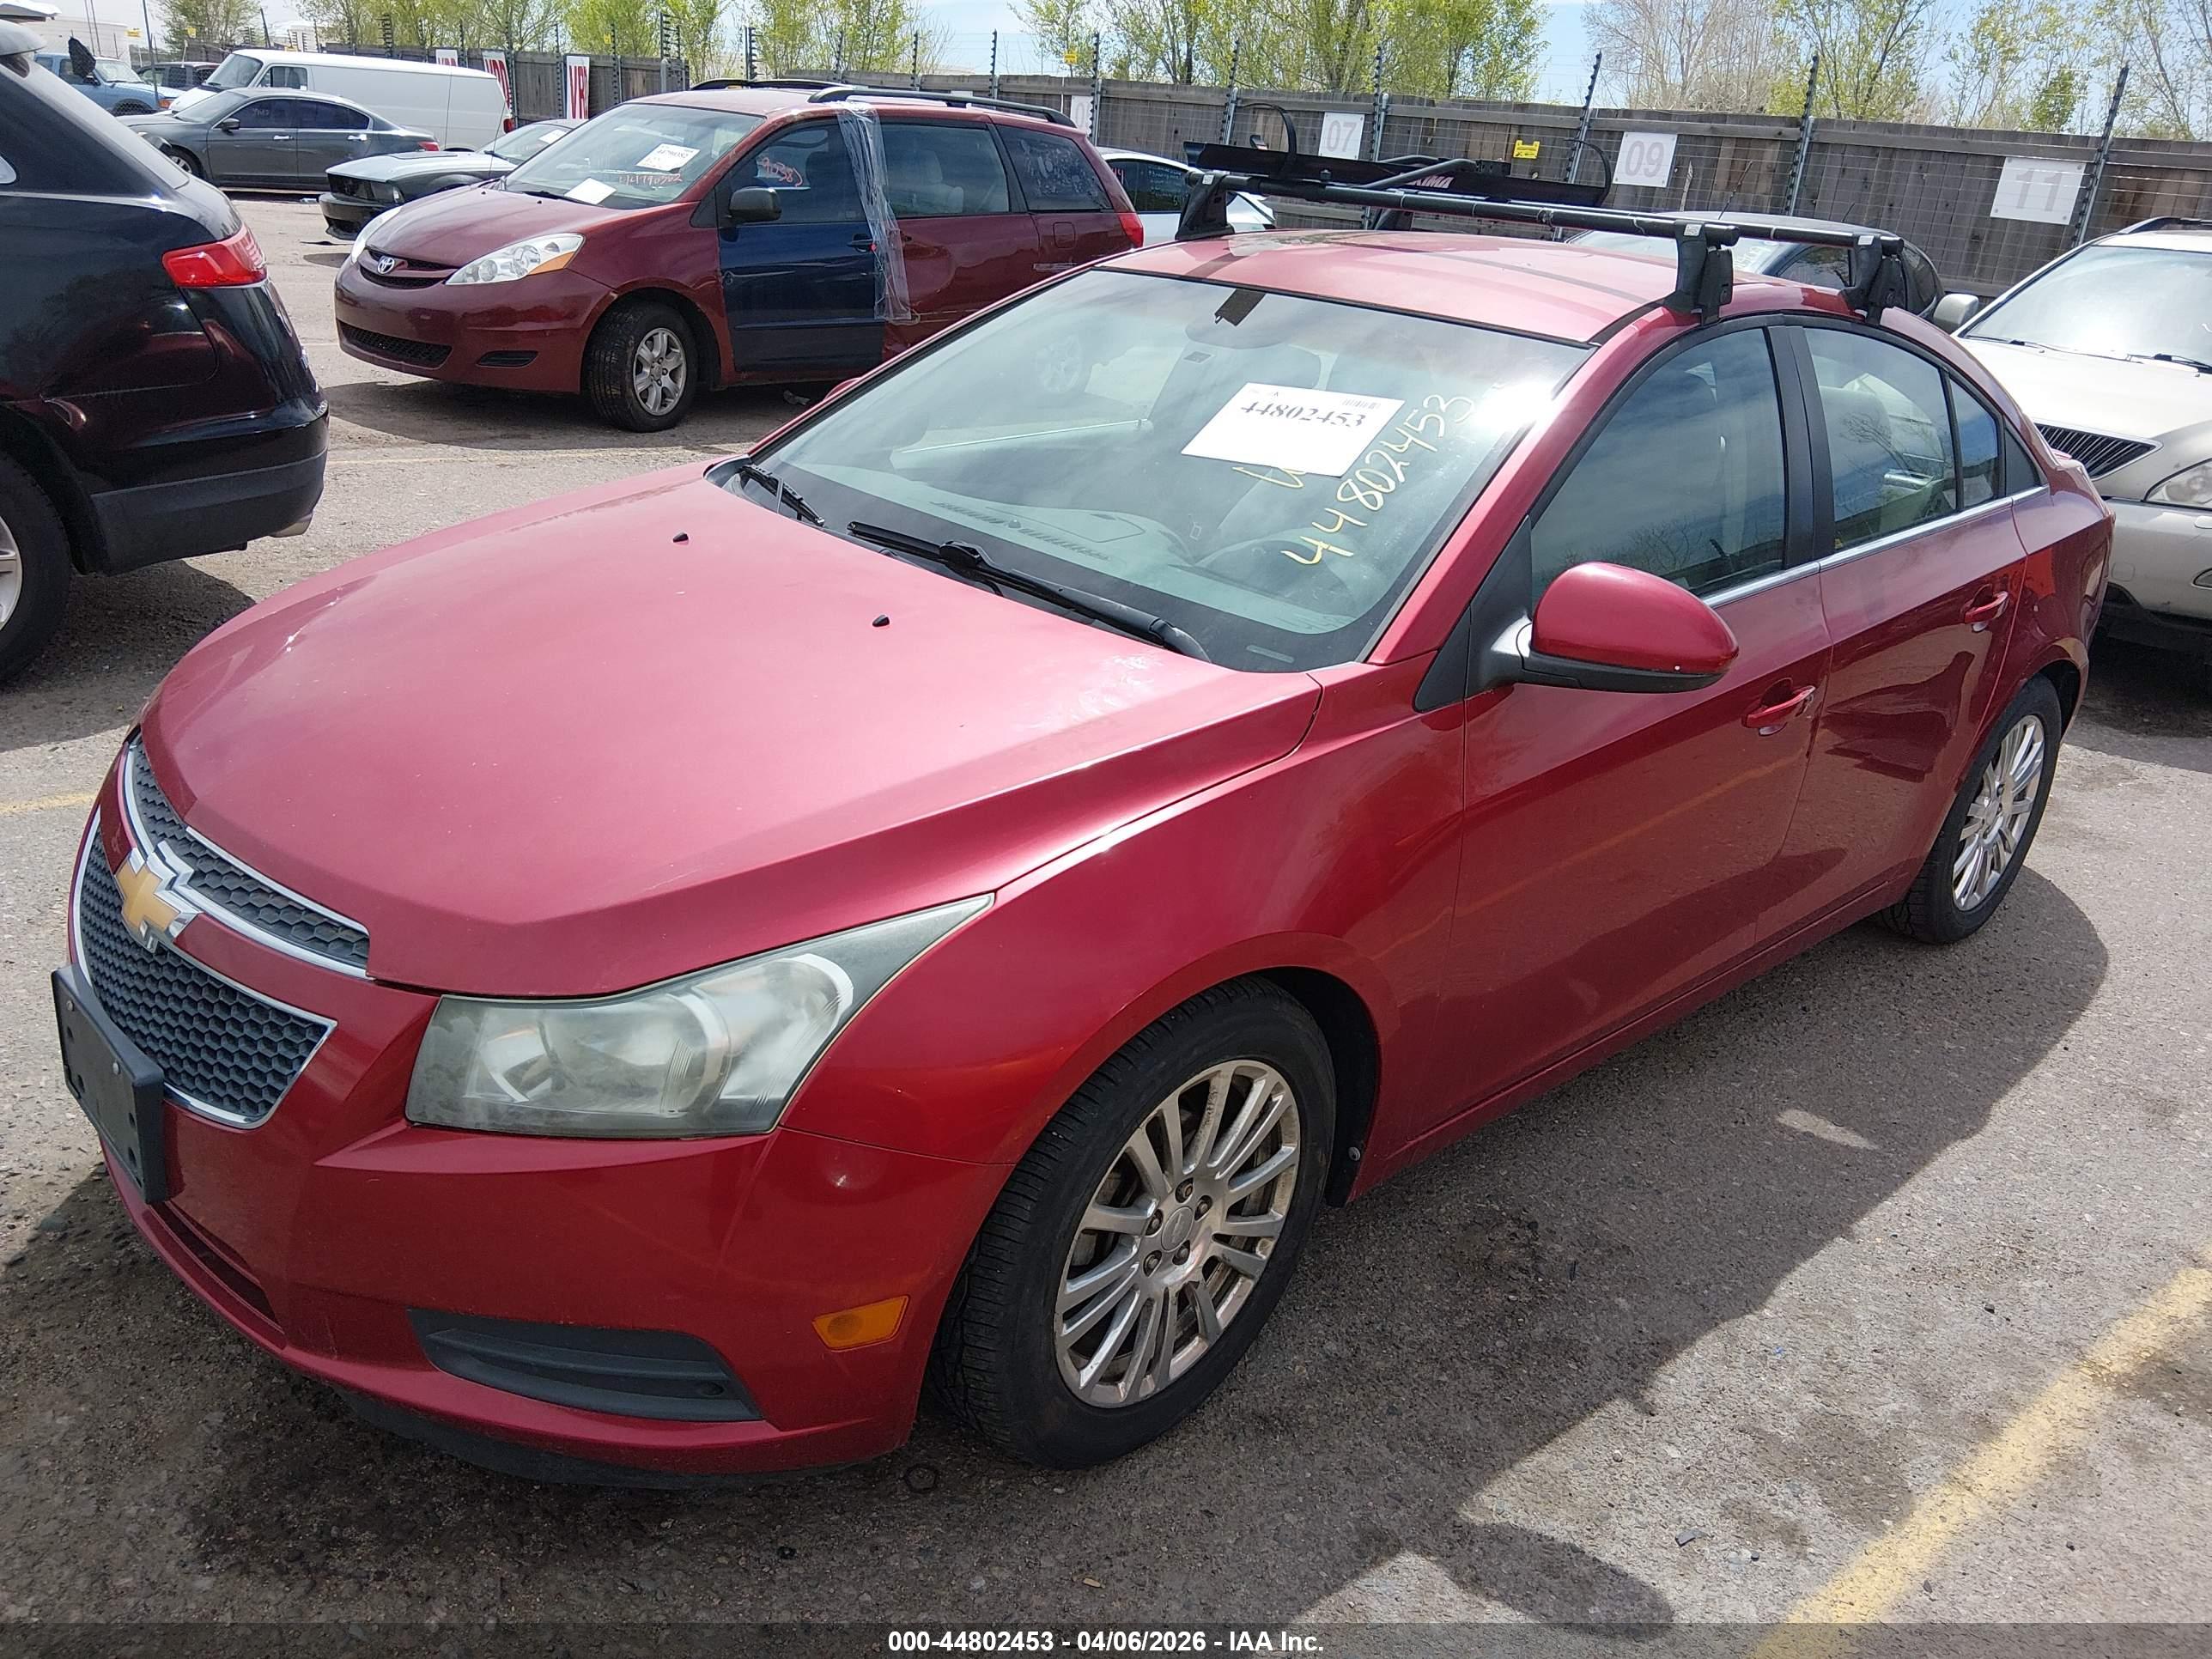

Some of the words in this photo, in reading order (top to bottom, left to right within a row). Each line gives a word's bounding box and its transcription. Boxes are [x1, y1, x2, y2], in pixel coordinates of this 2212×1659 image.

[1326, 119, 1358, 153] 07
[1624, 139, 1665, 178] 09
[2015, 168, 2063, 212] 11
[1240, 400, 1367, 428] 44802453
[1280, 394, 1474, 565] 44802453
